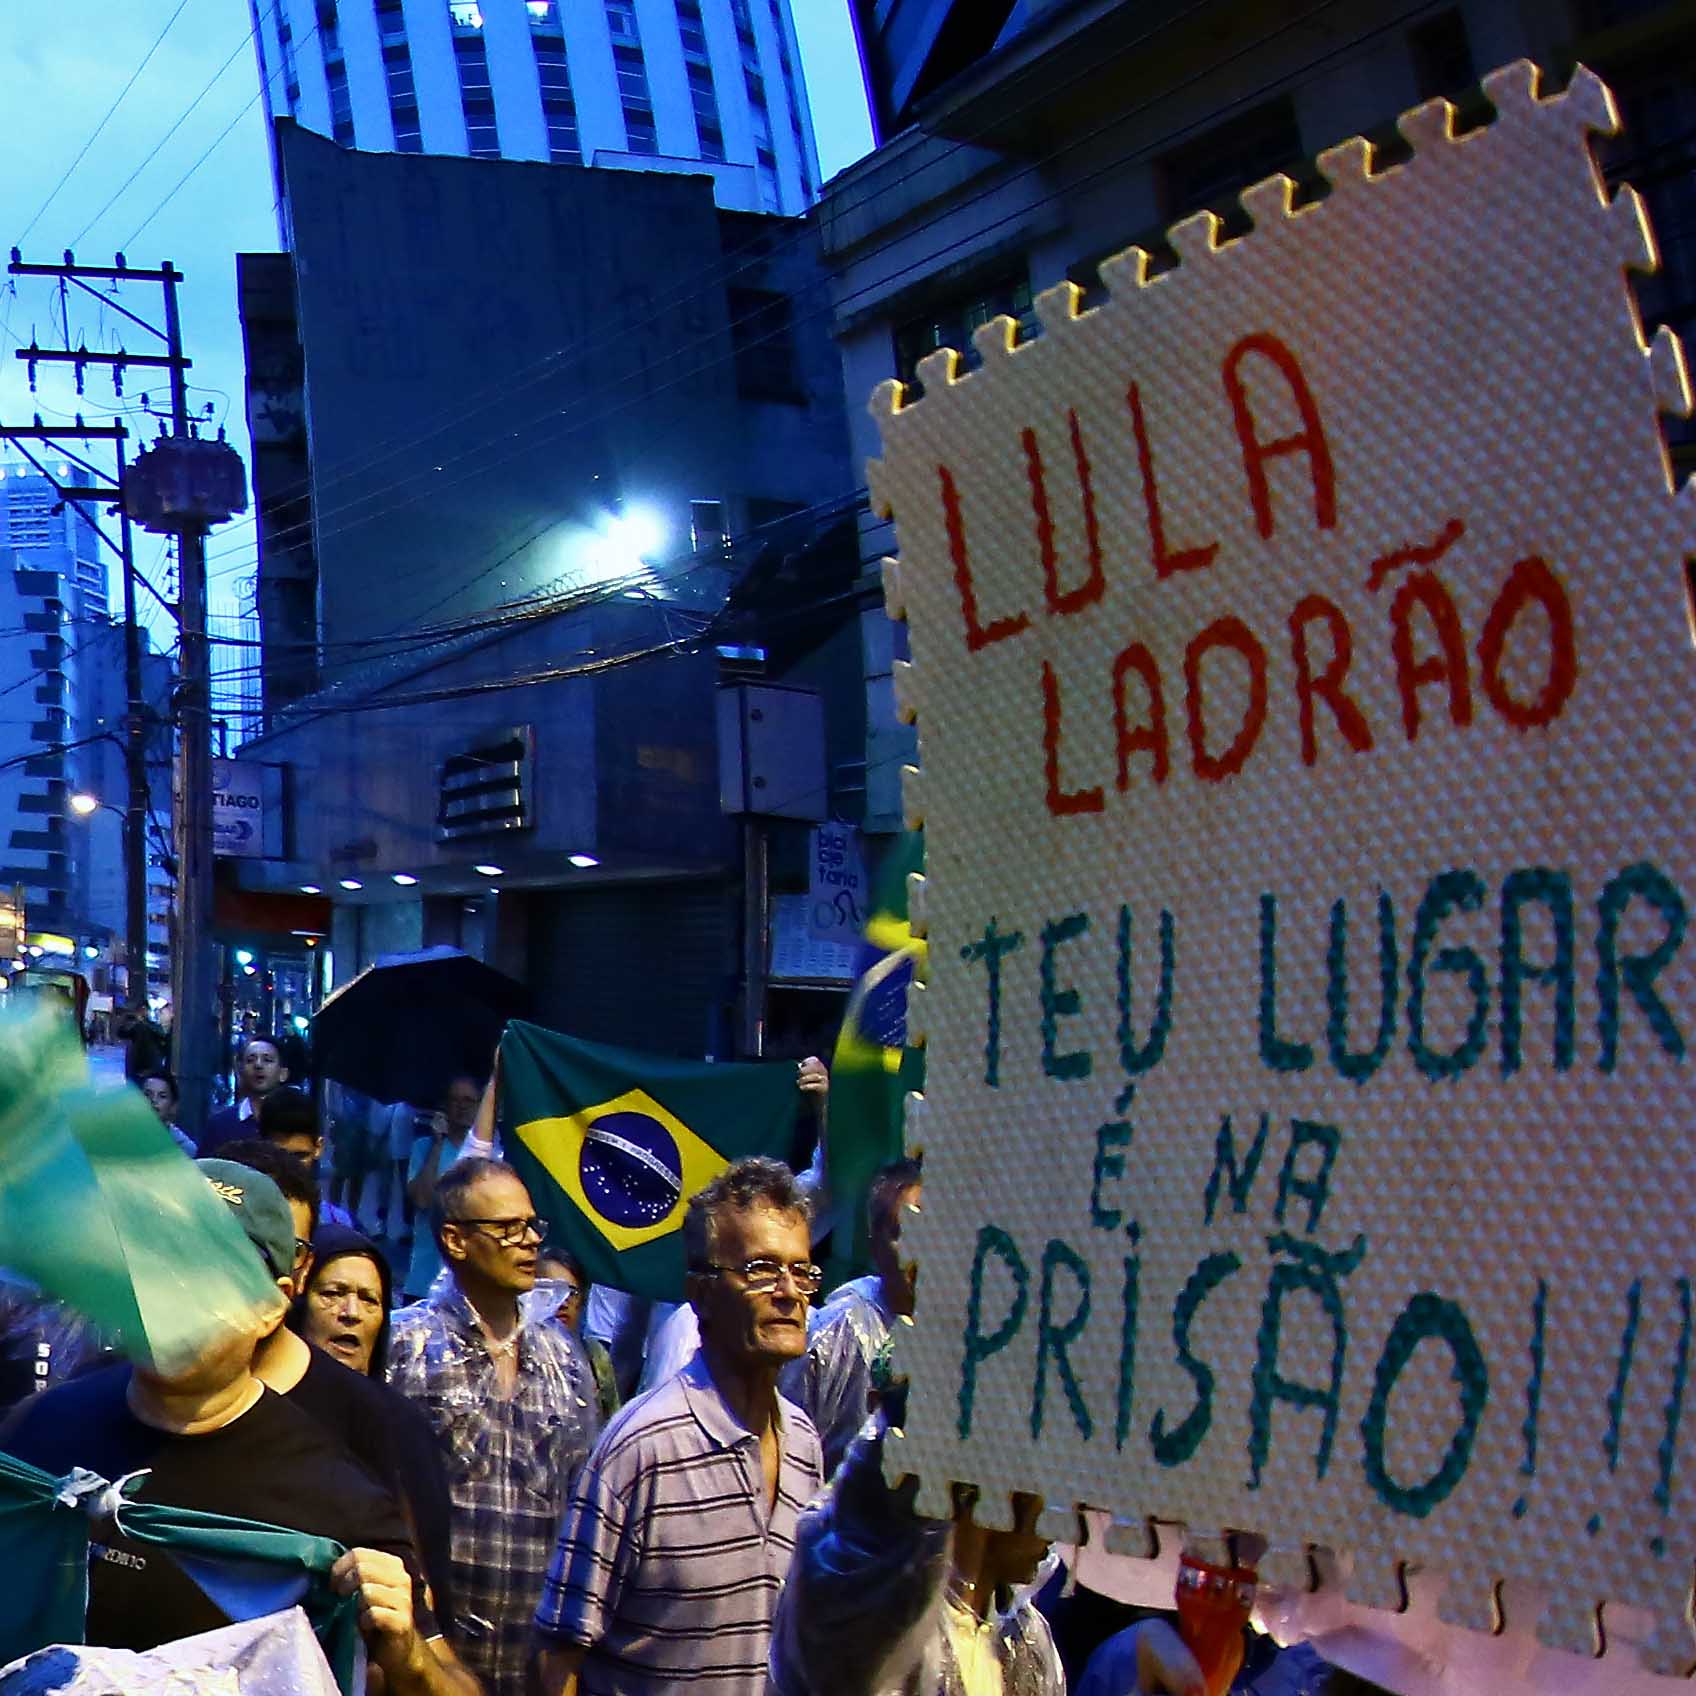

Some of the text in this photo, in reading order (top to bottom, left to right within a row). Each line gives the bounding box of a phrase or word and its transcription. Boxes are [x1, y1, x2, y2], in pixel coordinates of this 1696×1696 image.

[939, 332, 1339, 651] LULA
[1042, 519, 1579, 815] LADRÃO
[960, 861, 1691, 1088] TEU LUGAR
[1090, 1083, 1344, 1233] É NA
